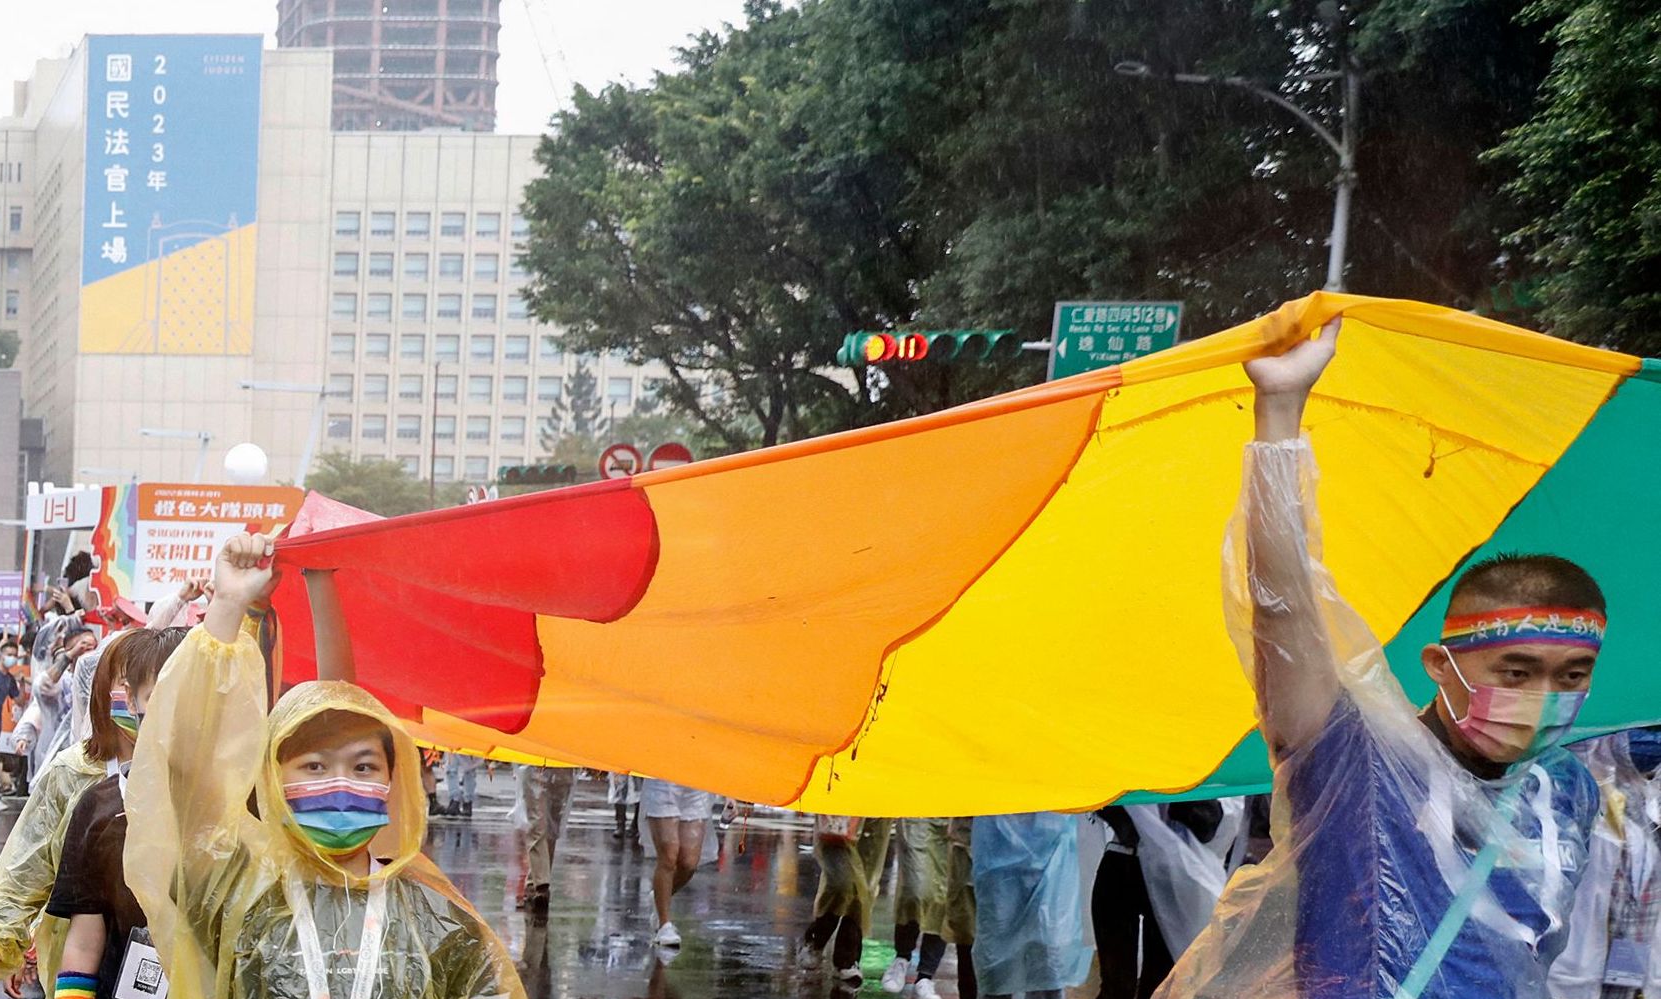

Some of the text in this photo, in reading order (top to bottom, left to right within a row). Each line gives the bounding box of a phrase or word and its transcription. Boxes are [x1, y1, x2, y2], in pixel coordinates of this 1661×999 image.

[102, 54, 132, 264] 國民法官上場
[146, 55, 168, 191] 2023年
[1071, 306, 1167, 323] 仁愛路四段512巷
[154, 500, 287, 519] 橙色大隊頭車
